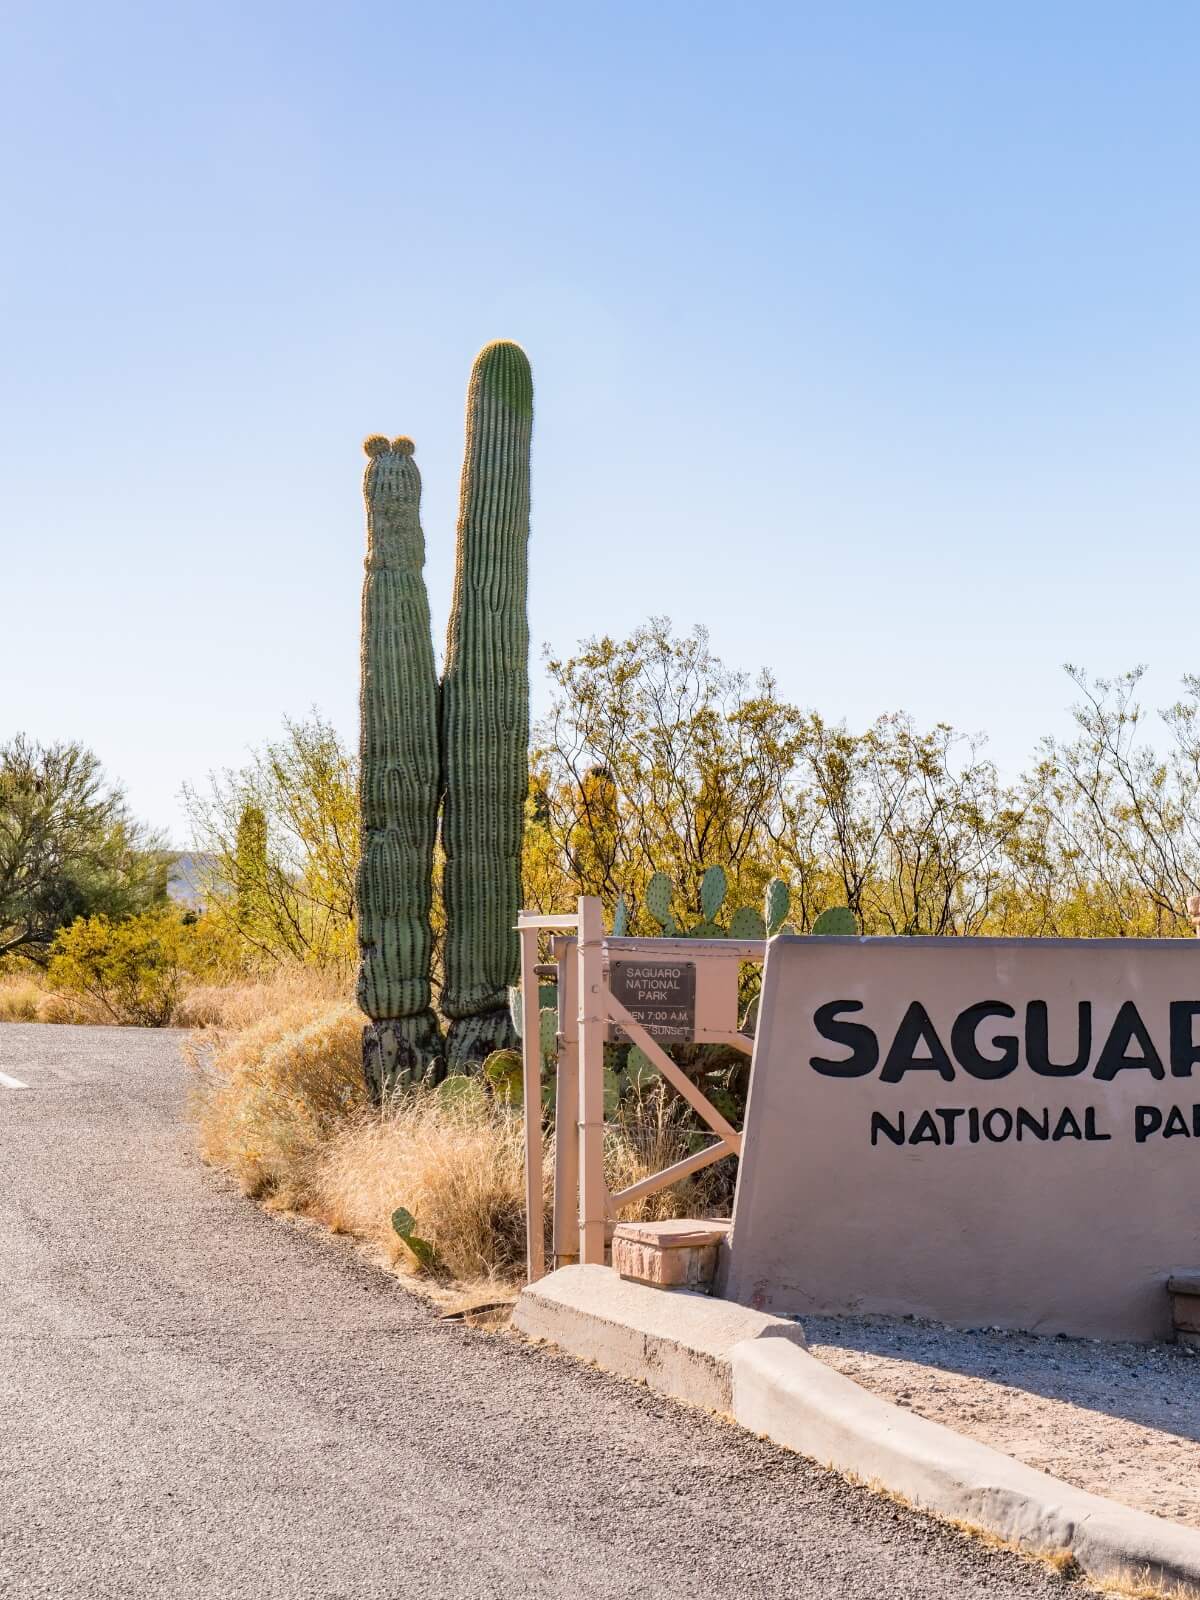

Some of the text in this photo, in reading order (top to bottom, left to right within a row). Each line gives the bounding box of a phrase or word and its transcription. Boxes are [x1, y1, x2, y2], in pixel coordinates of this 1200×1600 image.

[626, 968, 680, 978] SAGUARO
[626, 980, 680, 989] NATIONAL
[638, 991, 668, 1001] PARK
[647, 1011, 667, 1020] 7:00
[651, 1026, 689, 1035] SUNSET
[870, 1106, 1112, 1147] NATIONAL
